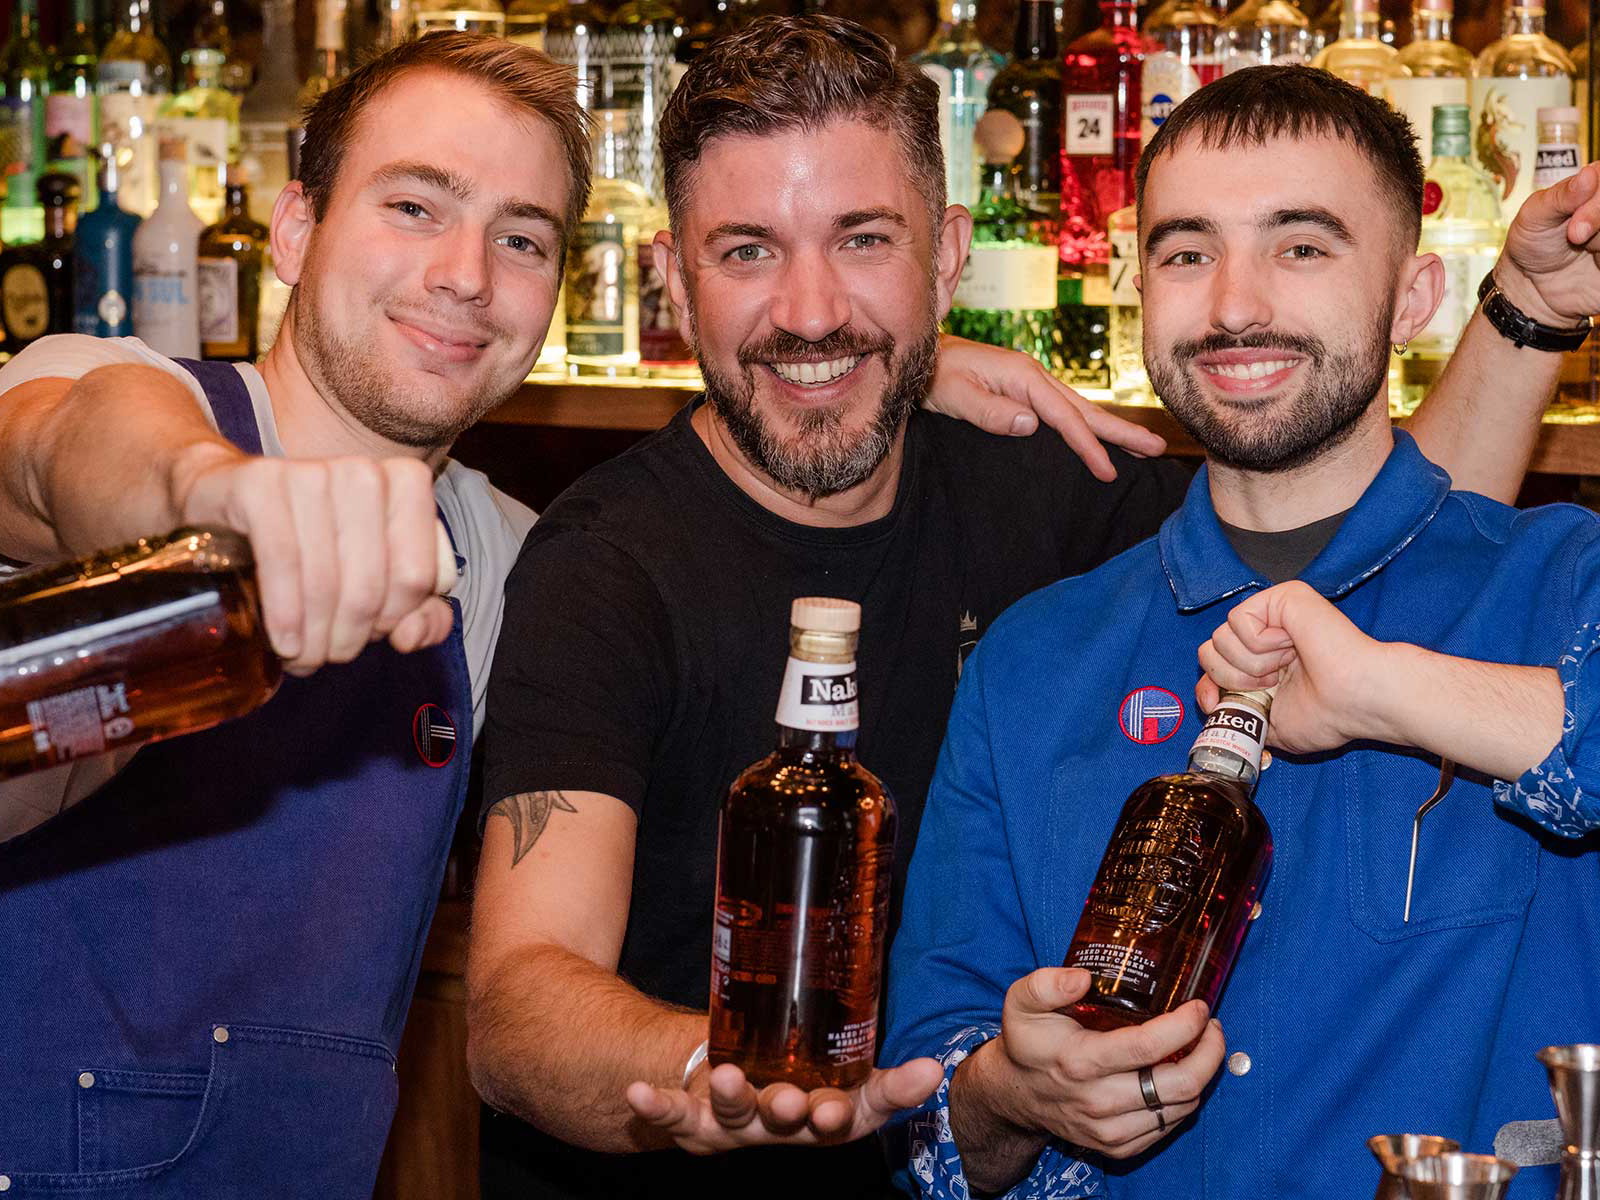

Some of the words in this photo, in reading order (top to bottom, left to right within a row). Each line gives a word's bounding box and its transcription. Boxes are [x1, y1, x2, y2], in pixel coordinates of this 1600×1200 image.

[1077, 117, 1100, 138] 24
[809, 677, 857, 701] Nak
[1205, 710, 1258, 737] aked
[1075, 948, 1101, 957] NAKED
[1079, 955, 1113, 963] SHERRY
[1114, 957, 1145, 971] CASKS
[828, 1031, 857, 1040] NAKED
